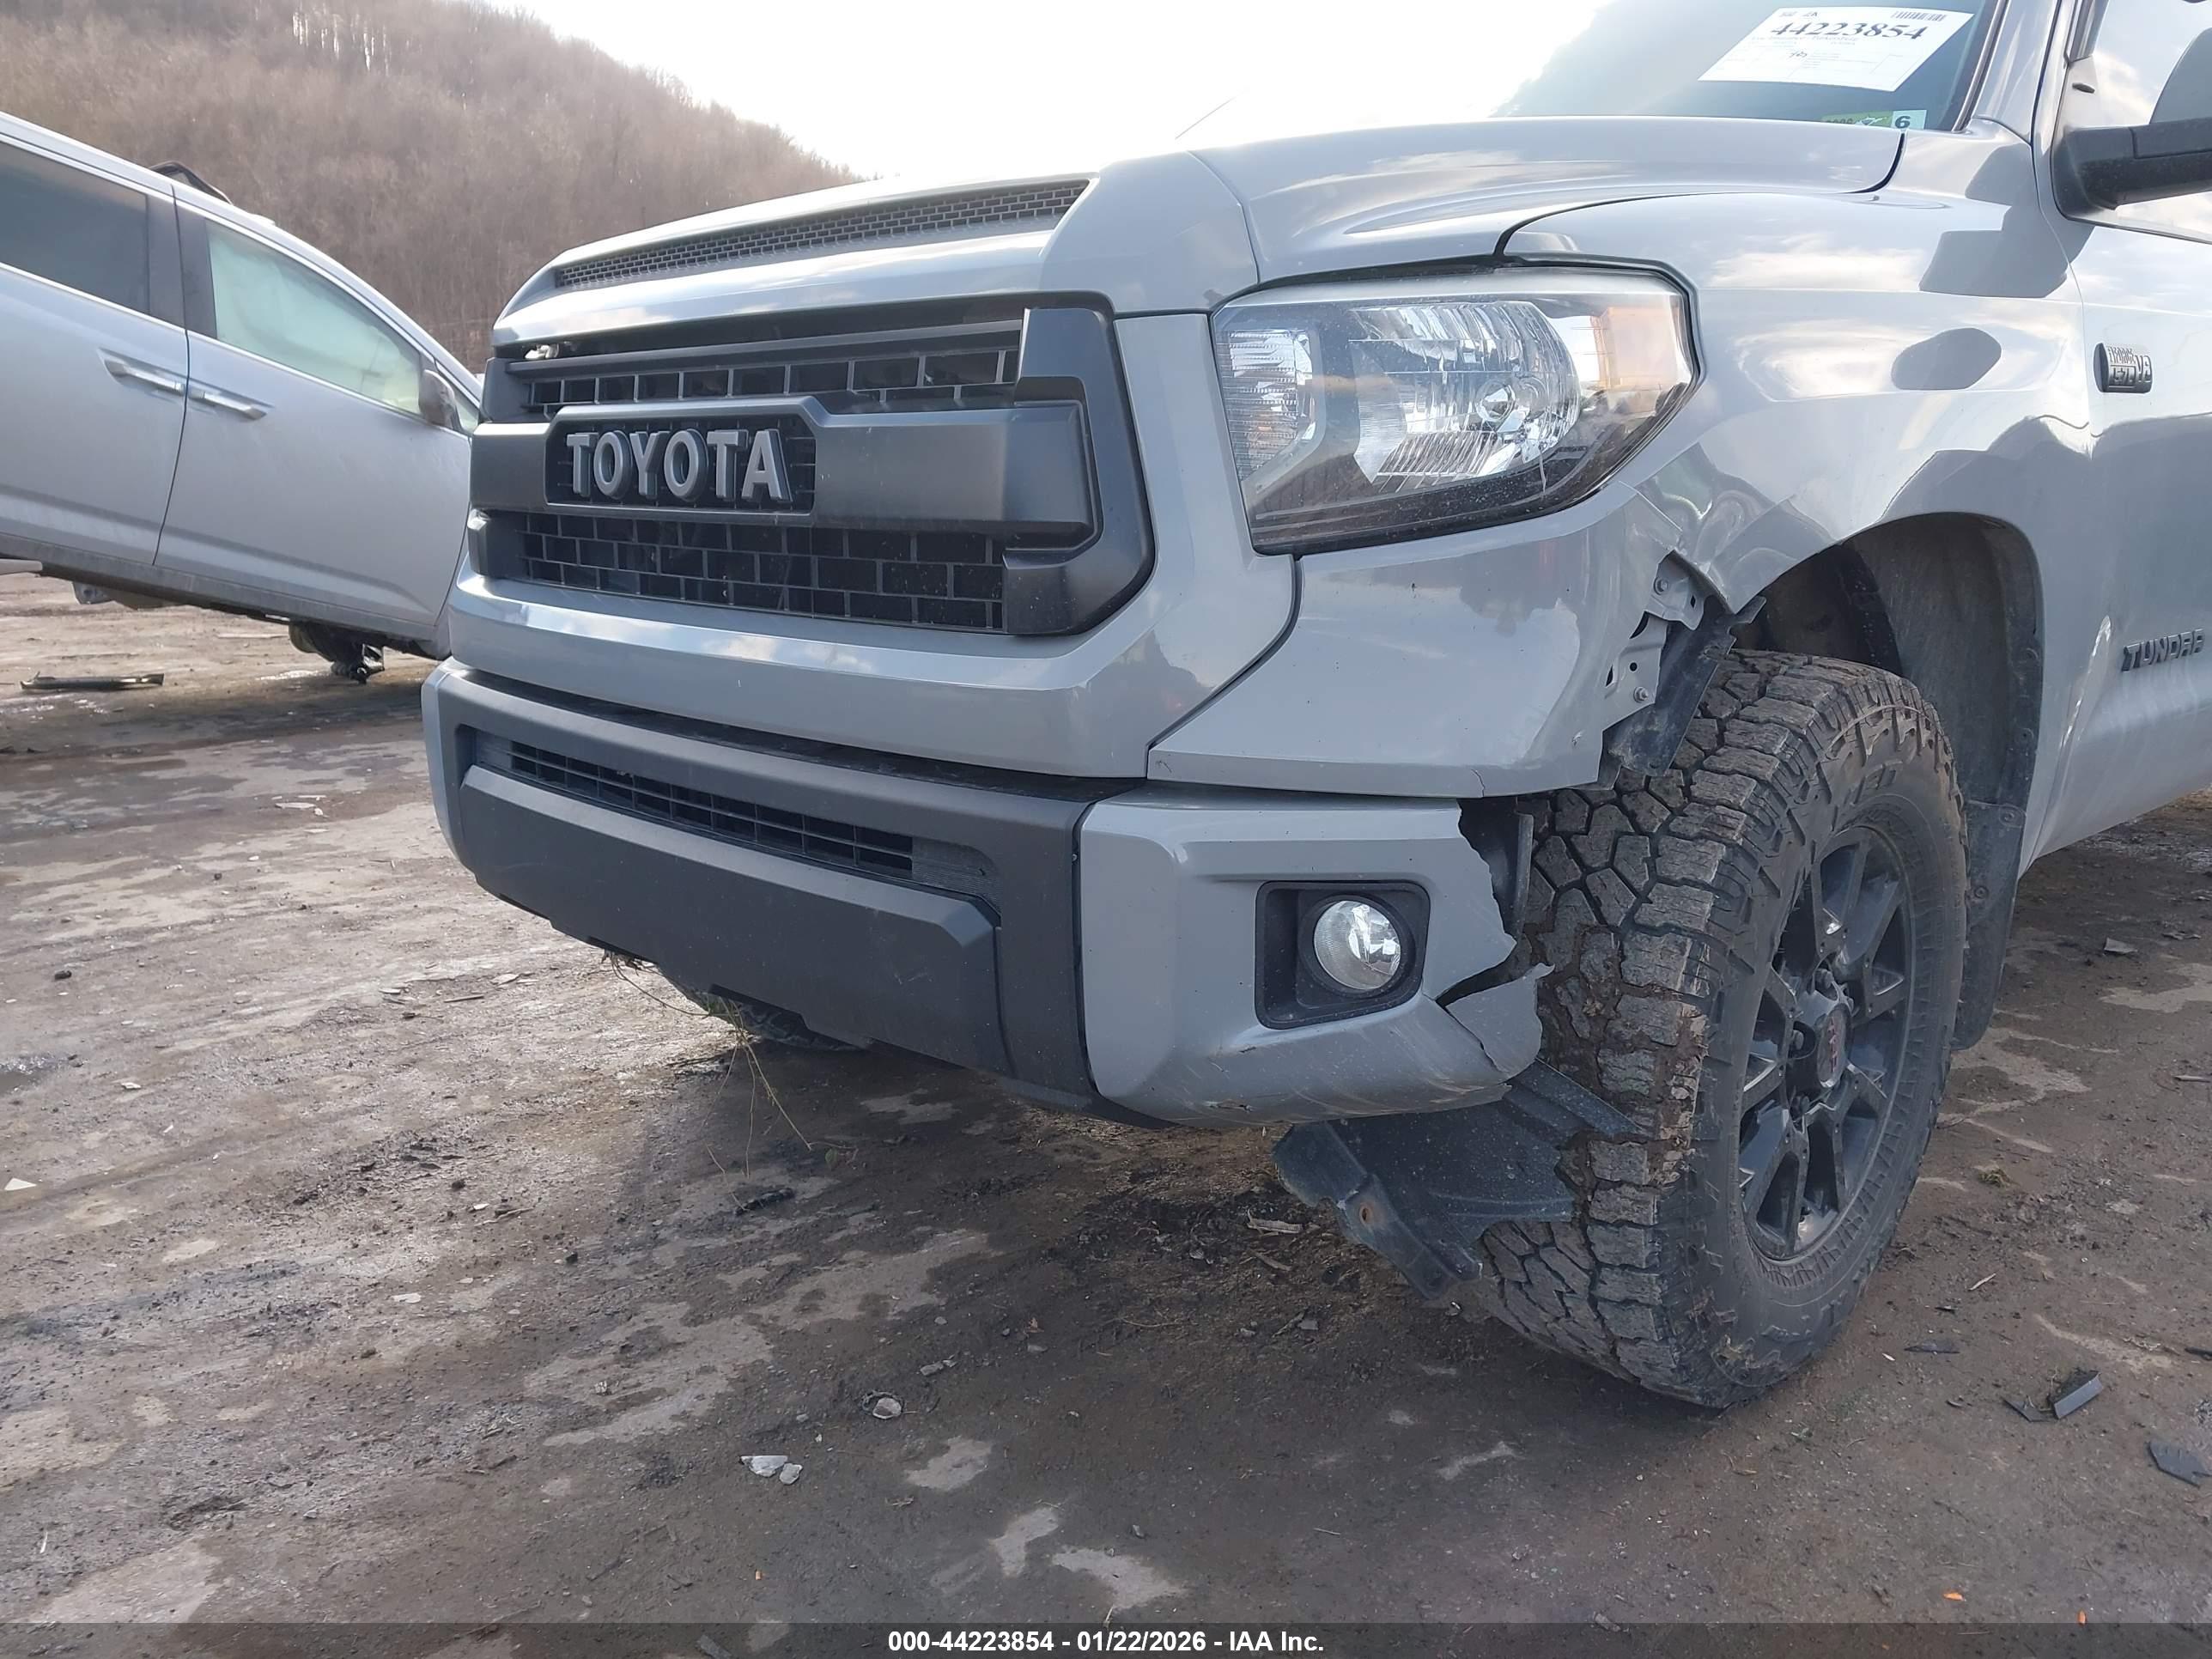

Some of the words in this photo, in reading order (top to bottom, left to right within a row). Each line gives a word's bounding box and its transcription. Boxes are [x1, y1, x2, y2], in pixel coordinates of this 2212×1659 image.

[1771, 21, 1929, 40] 44223854
[1894, 115, 1911, 129] 6
[567, 428, 790, 502] TOYOTA
[2121, 628, 2205, 672] TUNDRA
